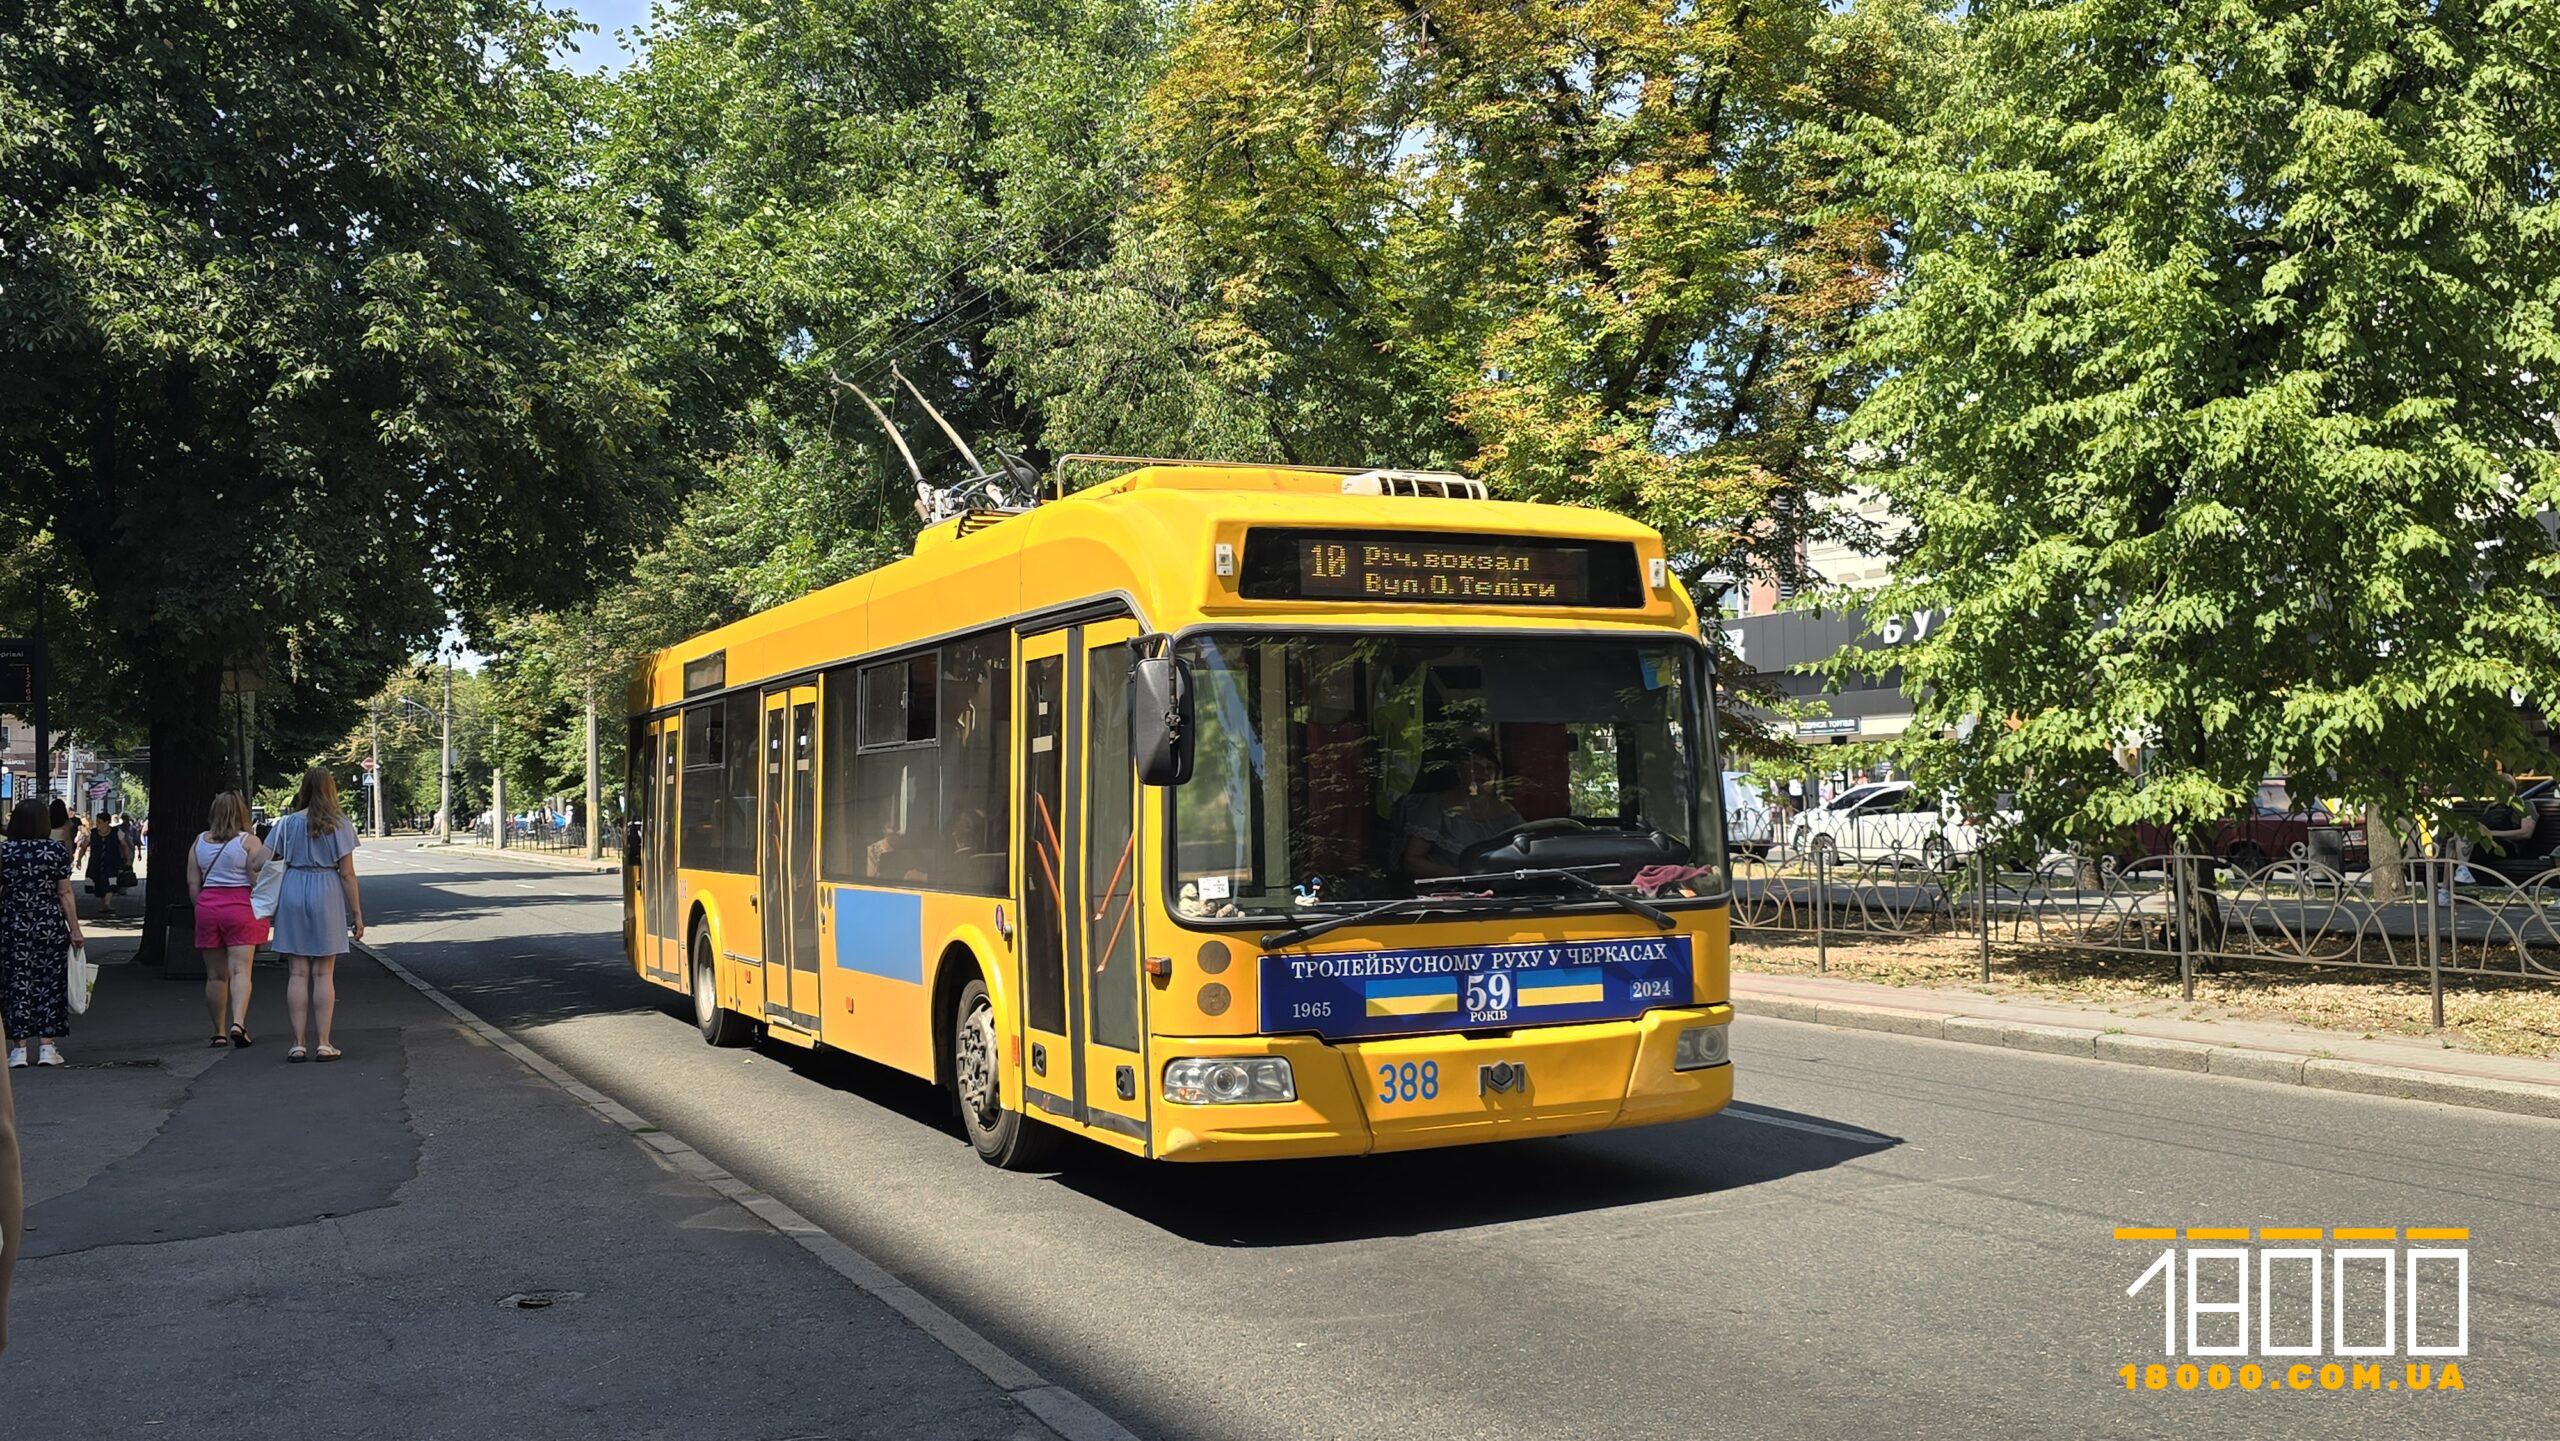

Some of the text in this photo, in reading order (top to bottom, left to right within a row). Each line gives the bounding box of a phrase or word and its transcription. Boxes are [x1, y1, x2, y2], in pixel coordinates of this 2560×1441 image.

[1310, 545, 1346, 577] 10
[1291, 943, 1668, 979] ТРОЛЕЙБУСНОМУ РУХУ У ЧЕРКАСАХ
[1465, 973, 1512, 1012] 59
[1632, 980, 1672, 998] 2024
[1292, 1002, 1332, 1018] 1965
[1470, 1010, 1508, 1022] РОКІВ
[1378, 1060, 1439, 1104] 388
